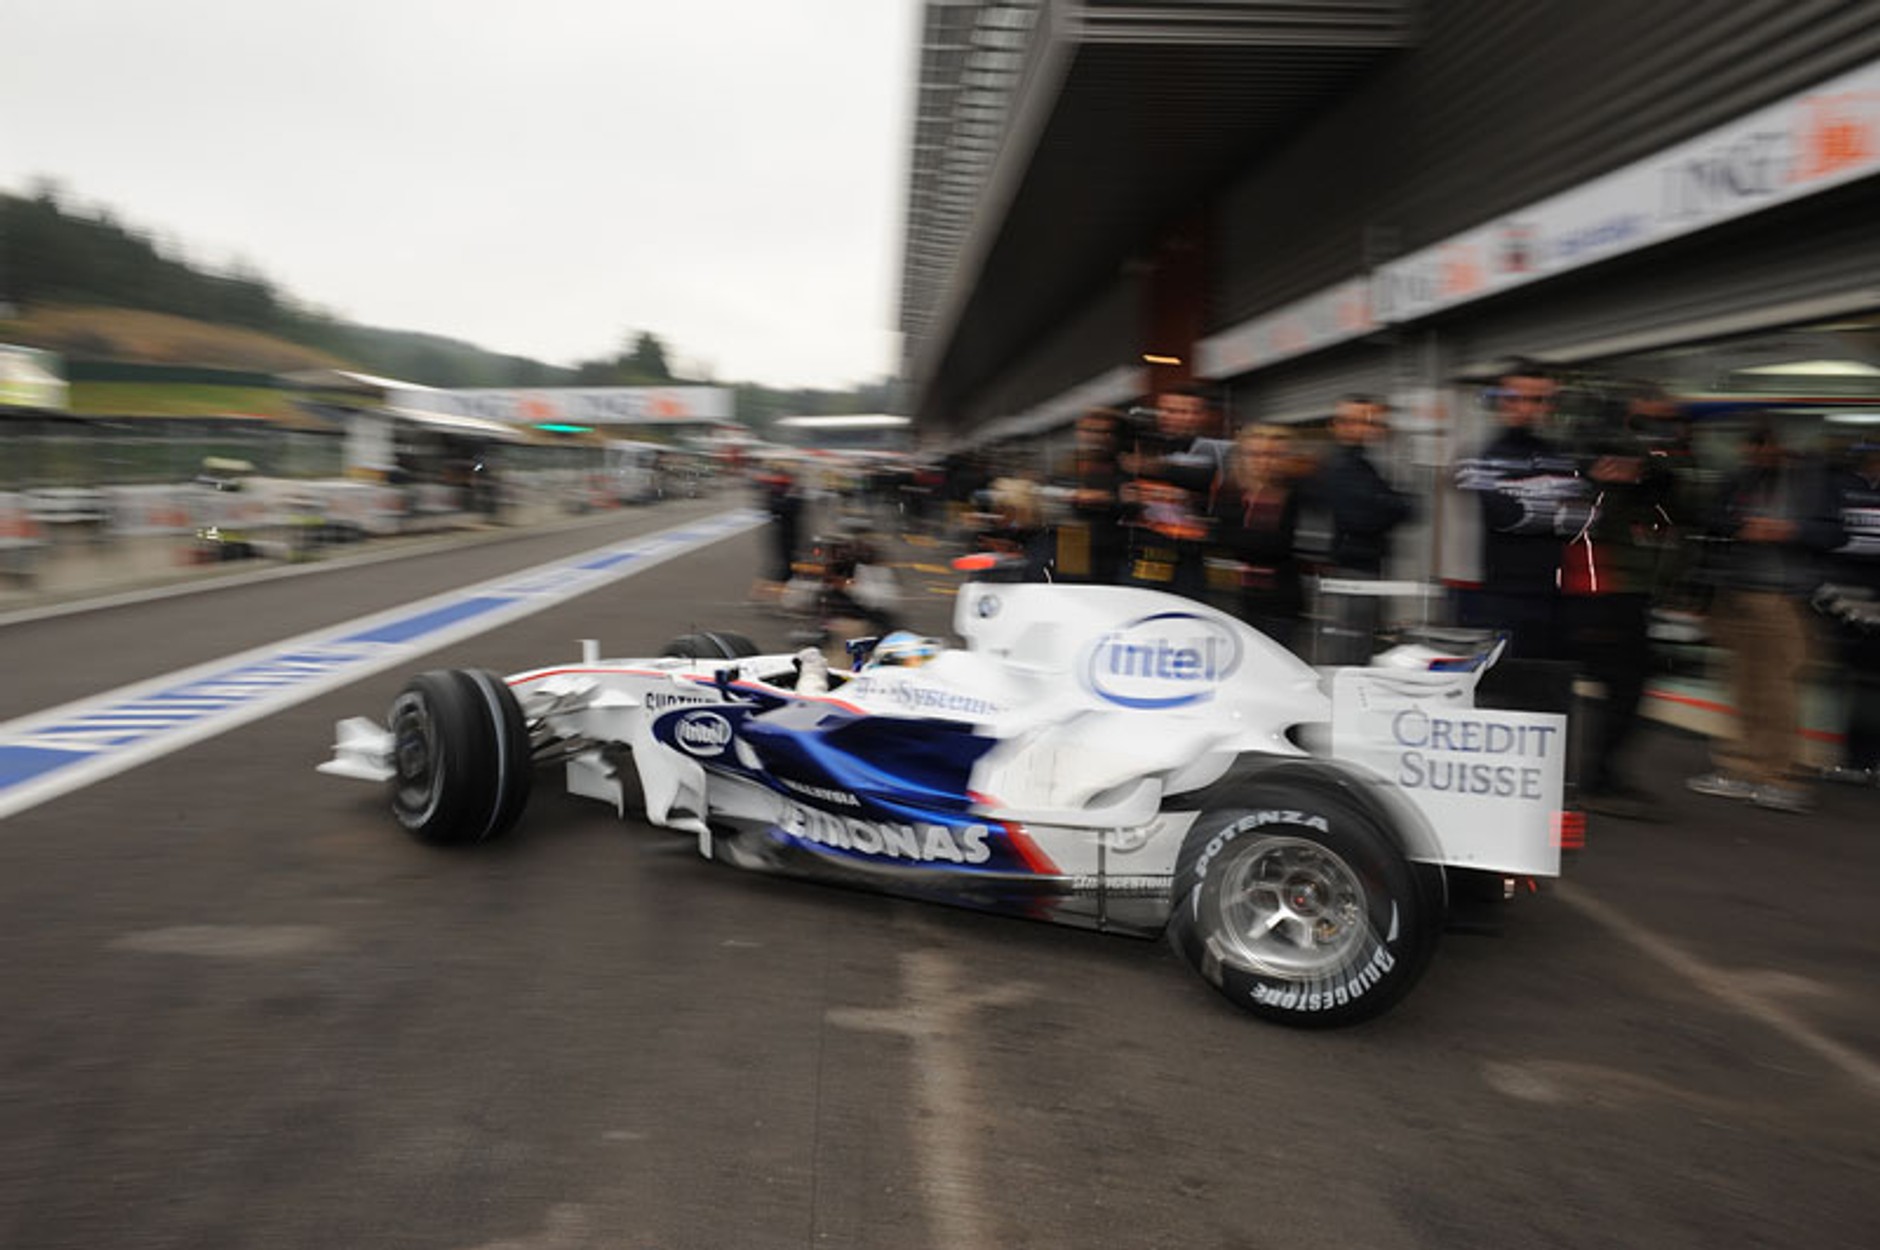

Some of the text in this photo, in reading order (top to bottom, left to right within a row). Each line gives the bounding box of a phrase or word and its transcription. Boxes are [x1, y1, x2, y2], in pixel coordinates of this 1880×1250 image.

[1108, 632, 1217, 681] intel
[1392, 709, 1557, 757] CREDIT
[1400, 751, 1543, 800] SUISSE
[779, 800, 991, 864] ETRONAS
[1195, 809, 1330, 878] POTENZA
[1250, 946, 1396, 1011] BRIDGESTONE
